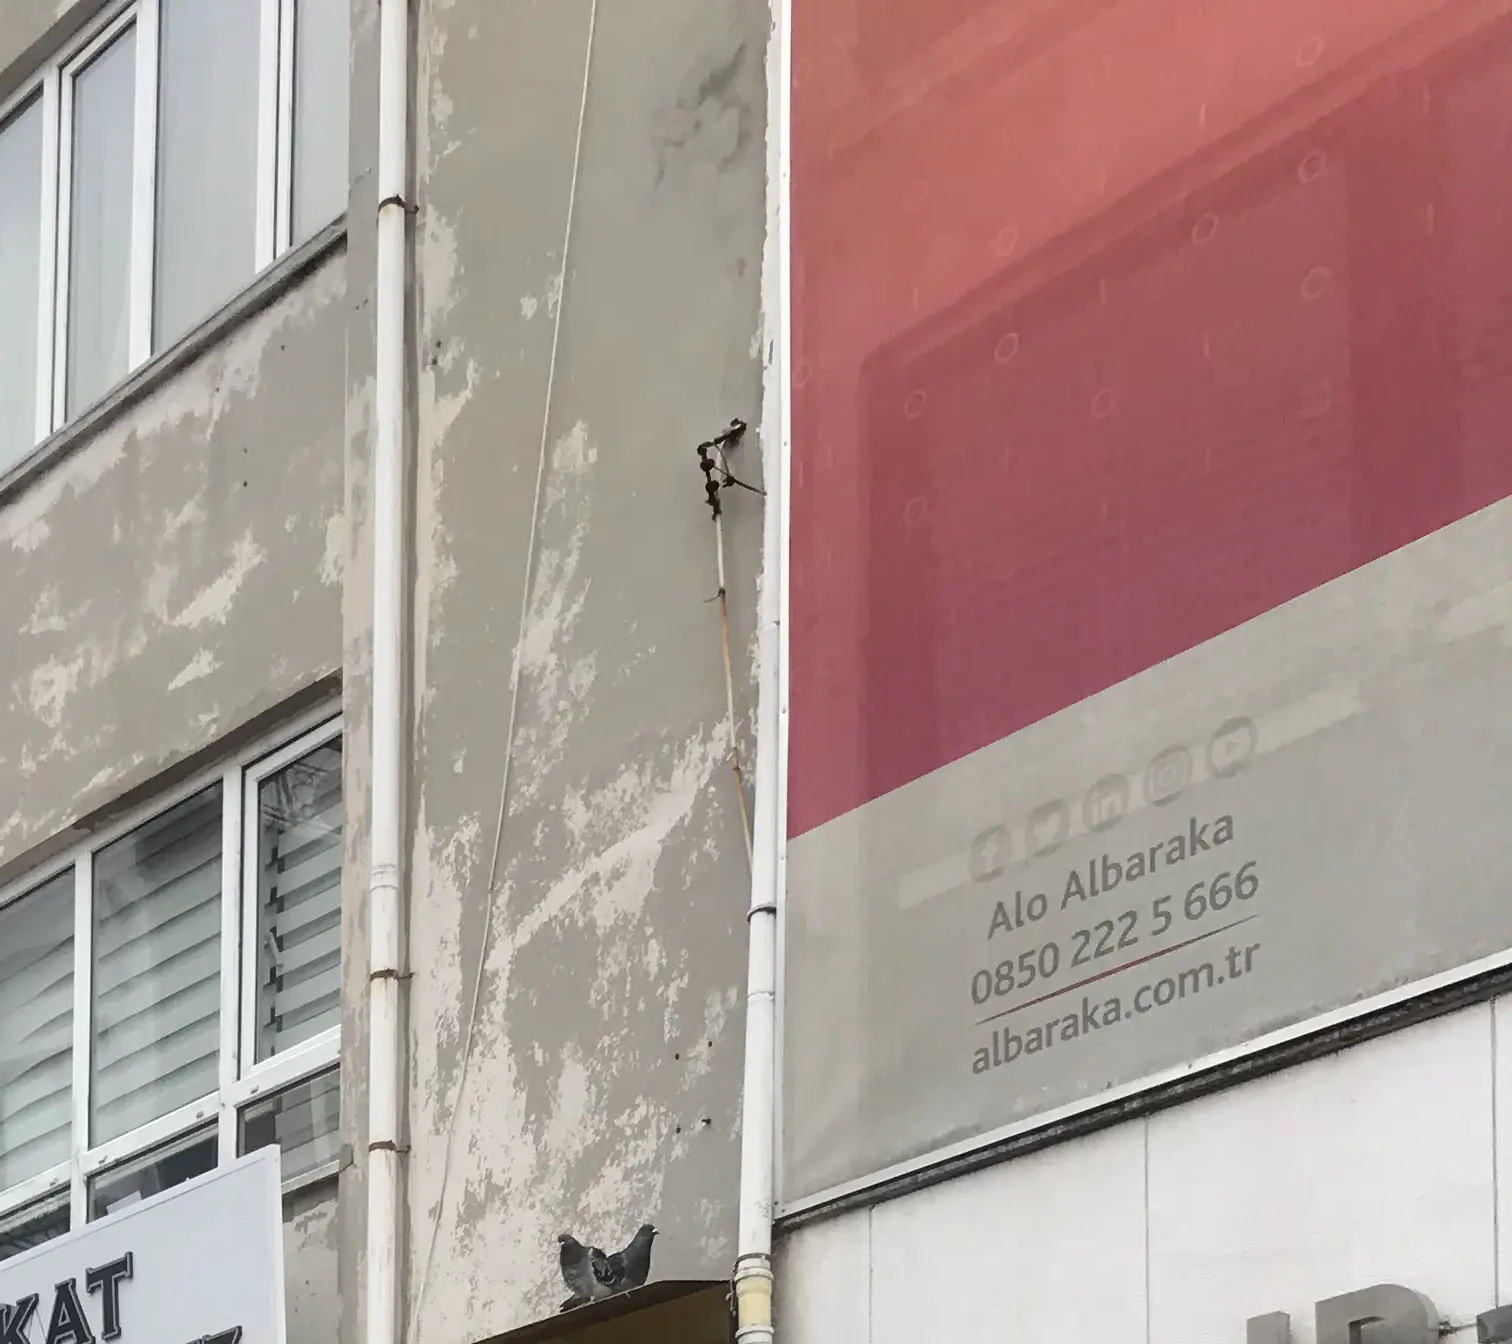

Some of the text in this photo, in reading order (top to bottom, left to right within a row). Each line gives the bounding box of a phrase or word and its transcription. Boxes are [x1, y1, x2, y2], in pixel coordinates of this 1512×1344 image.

[971, 860, 1261, 1006] 0850 222 5 666
[987, 813, 1235, 938] Alo Albaraka
[971, 938, 1262, 1076] albaraka.com.tr
